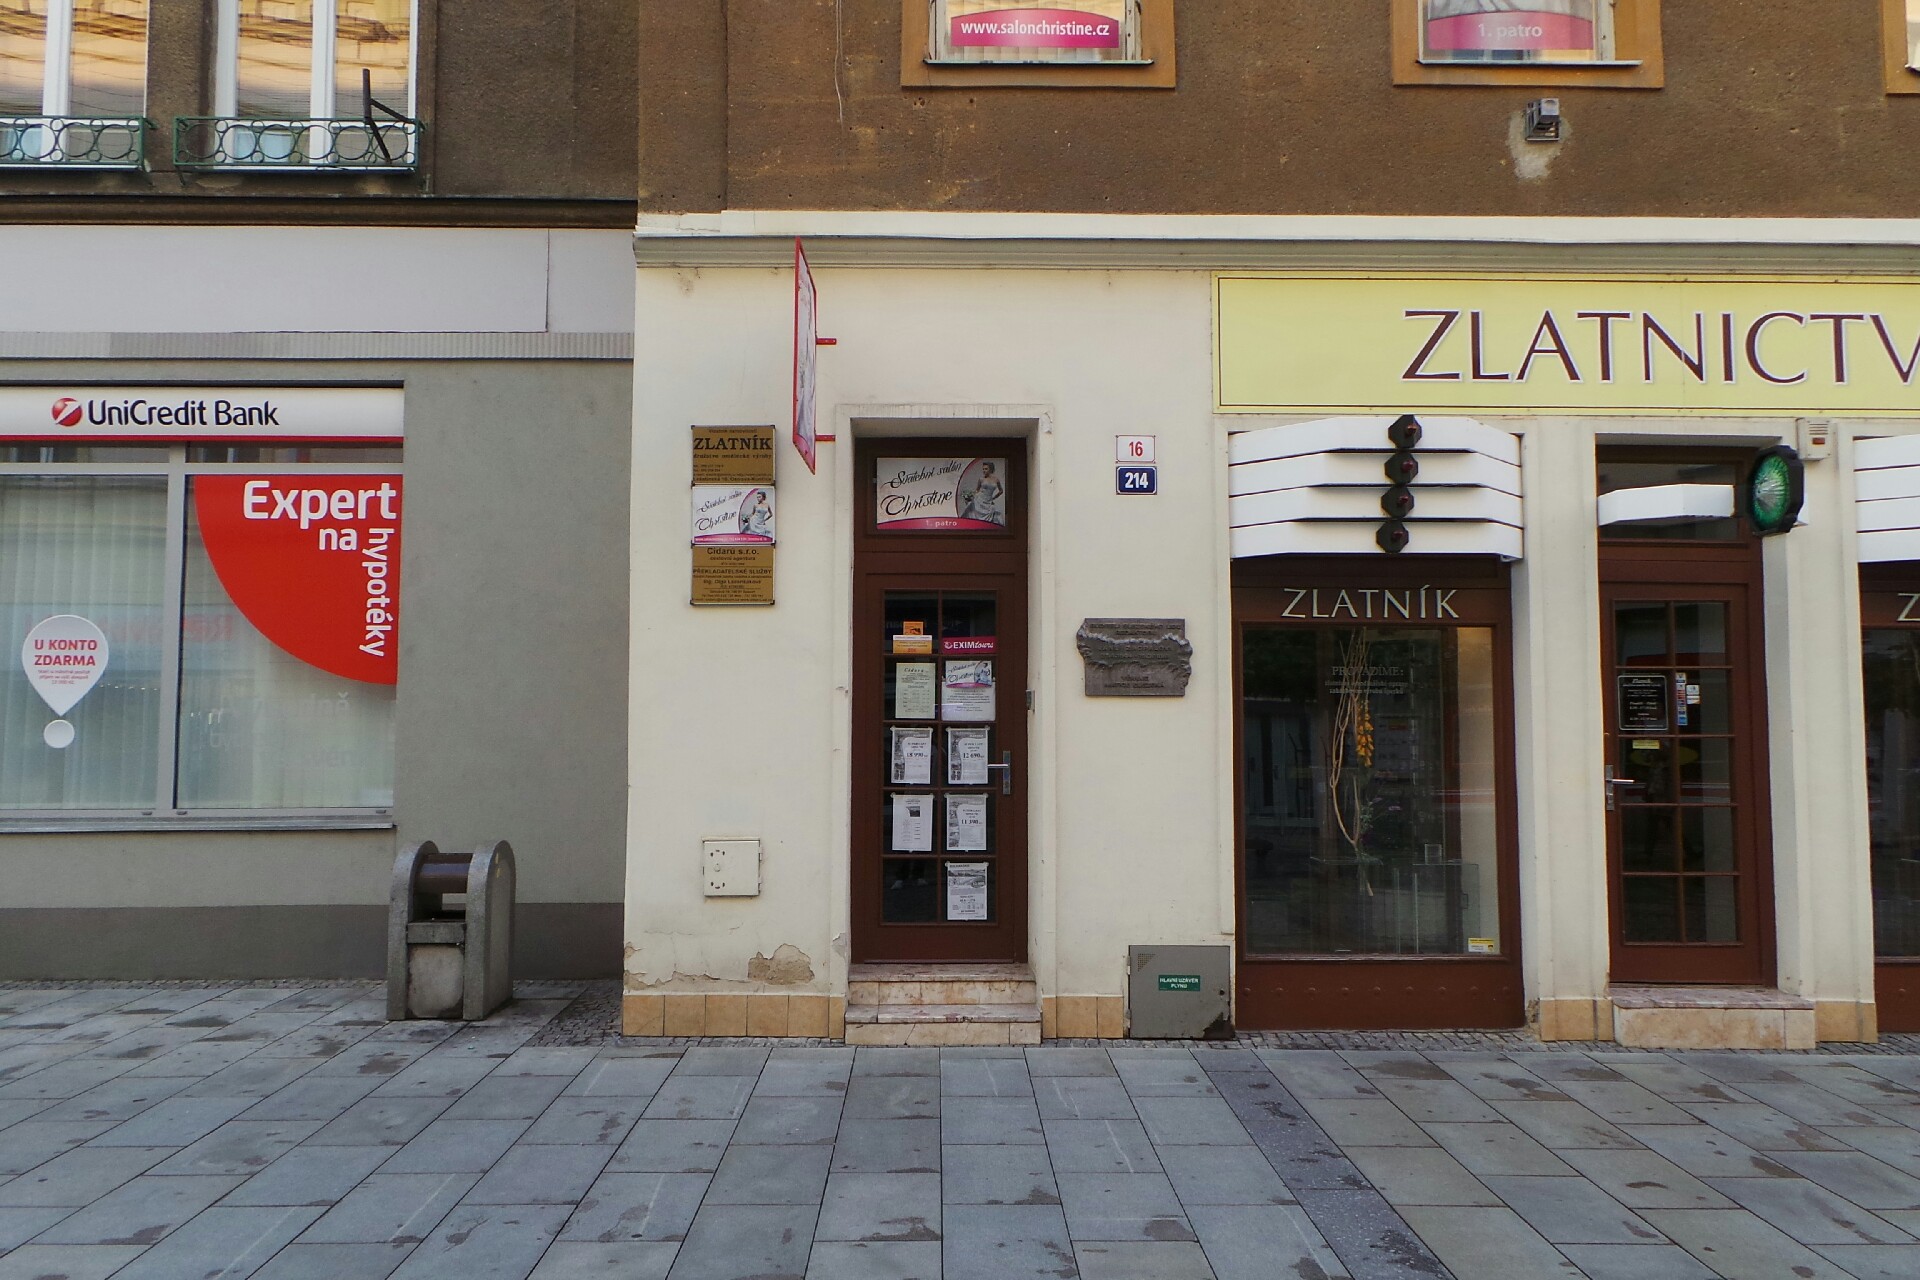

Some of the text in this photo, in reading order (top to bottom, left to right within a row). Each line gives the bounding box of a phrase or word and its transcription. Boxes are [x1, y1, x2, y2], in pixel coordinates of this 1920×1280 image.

[961, 20, 1110, 37] www.salonchristine.cz
[1478, 23, 1543, 41] 1. patro
[1401, 309, 1920, 384] ZLATNICTV
[88, 399, 281, 426] UniCredit Bank
[694, 434, 773, 450] ZLATNÍK
[1128, 441, 1143, 457] 16
[1124, 472, 1149, 489] 214
[243, 480, 397, 530] Expert
[880, 489, 952, 516] Christine
[935, 519, 957, 528] patro
[319, 528, 358, 551] na
[359, 527, 395, 657] hypotéky
[1281, 584, 1460, 619] ZLATNÍK
[34, 639, 97, 651] U KONTO
[34, 654, 96, 667] ZDARMA
